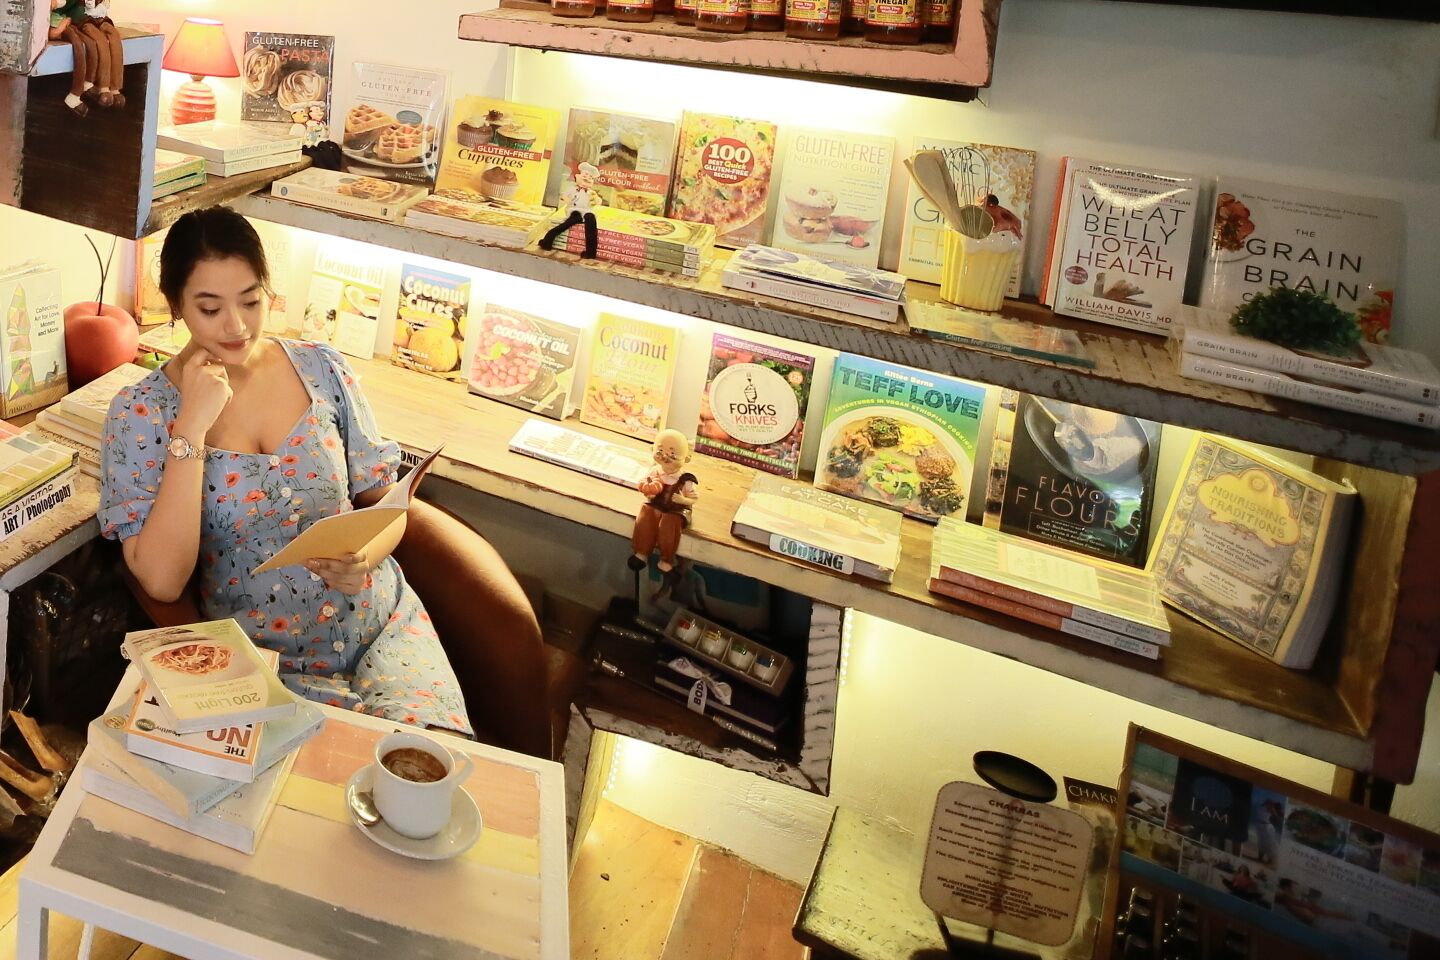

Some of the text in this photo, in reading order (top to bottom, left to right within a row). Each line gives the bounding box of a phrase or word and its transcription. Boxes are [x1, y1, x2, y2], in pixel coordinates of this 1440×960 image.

[252, 36, 319, 48] GLUTEN-FREE
[280, 48, 330, 63] PASTA
[361, 81, 432, 97] GLUTEN-FREE
[458, 148, 524, 169] Cupcakes
[477, 145, 535, 160] GLUTEN-FREE
[708, 143, 751, 163] 100
[795, 134, 886, 166] GLUTEN-FREE
[599, 169, 649, 181] GLUTEN-FREE
[704, 164, 749, 176] GLUTEN-FREE
[725, 160, 747, 170] Quick
[714, 171, 738, 180] RECIPES
[1084, 214, 1177, 245] BELLY
[1295, 228, 1316, 237] THE
[622, 248, 643, 257] VEGAN
[623, 240, 645, 249] VEGAN
[1088, 234, 1168, 263] TOTAL
[621, 256, 642, 265] VEGAN
[1076, 249, 1173, 281] HEALTH
[1246, 238, 1362, 273] GRAIN
[403, 276, 467, 303] Coconut
[1244, 265, 1359, 301] BRAIN
[405, 291, 455, 320] Cures
[1065, 296, 1113, 313] WILLIAM
[1156, 316, 1172, 324] MD
[492, 326, 570, 356] COCONUT OIL
[599, 323, 669, 361] Coconut
[1196, 340, 1259, 359] GRAIN BRAIN
[1194, 366, 1255, 384] GRAIN BRAIN
[840, 366, 980, 420] TEFF LOVE
[729, 403, 776, 417] FORKS
[735, 415, 778, 426] KNIVES
[3, 513, 20, 536] ART
[26, 483, 72, 521] Photography
[780, 486, 869, 517] EAT CAKE
[1211, 485, 1288, 526] NOURISHING
[1015, 487, 1140, 537] FLOURS
[1209, 495, 1285, 539] TRADITIONS
[778, 538, 844, 571] COOKING
[195, 692, 260, 710] 200 Light
[224, 745, 246, 757] THE
[988, 799, 1041, 818] CHAKRAS
